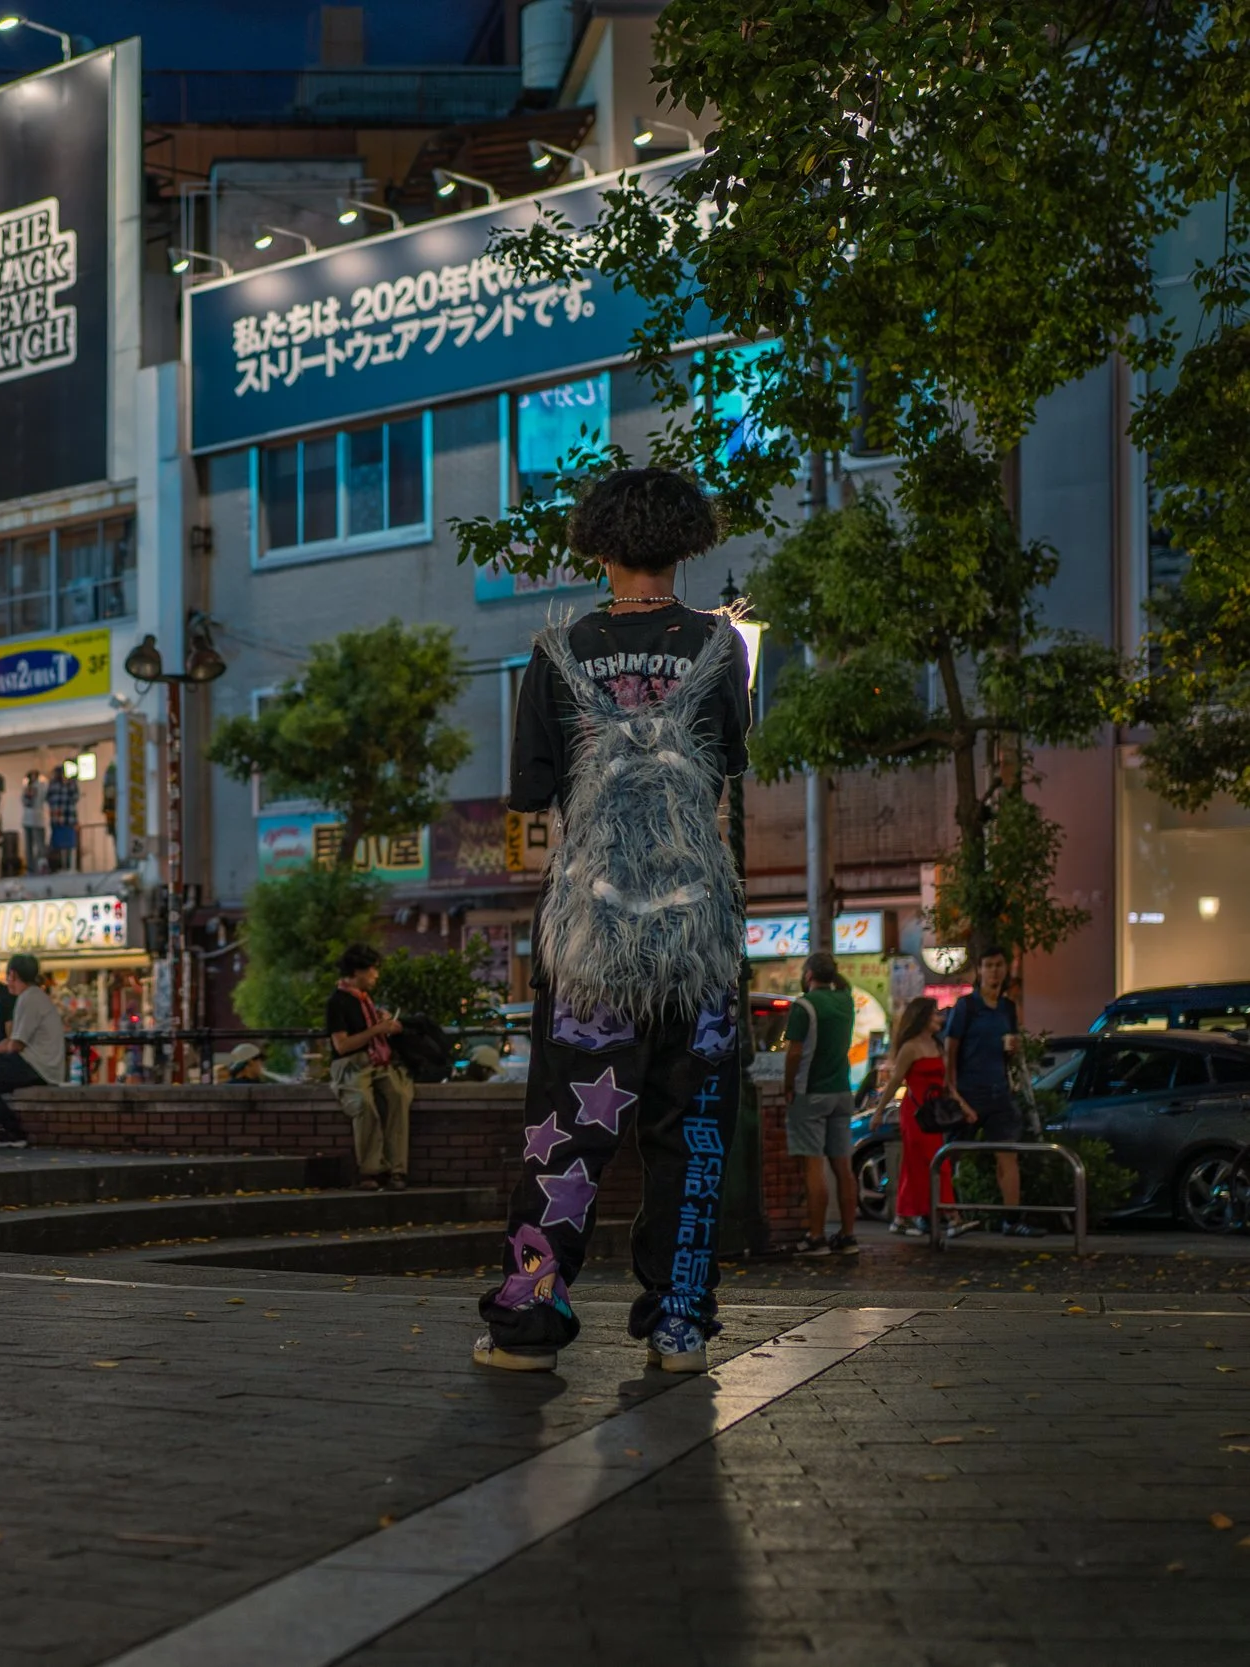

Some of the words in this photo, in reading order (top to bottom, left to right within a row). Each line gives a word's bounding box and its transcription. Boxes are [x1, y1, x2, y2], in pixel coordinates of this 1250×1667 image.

[234, 278, 595, 397] ストリートウェアブランドです。
[88, 654, 108, 674] 3F
[6, 901, 78, 949] CAPS
